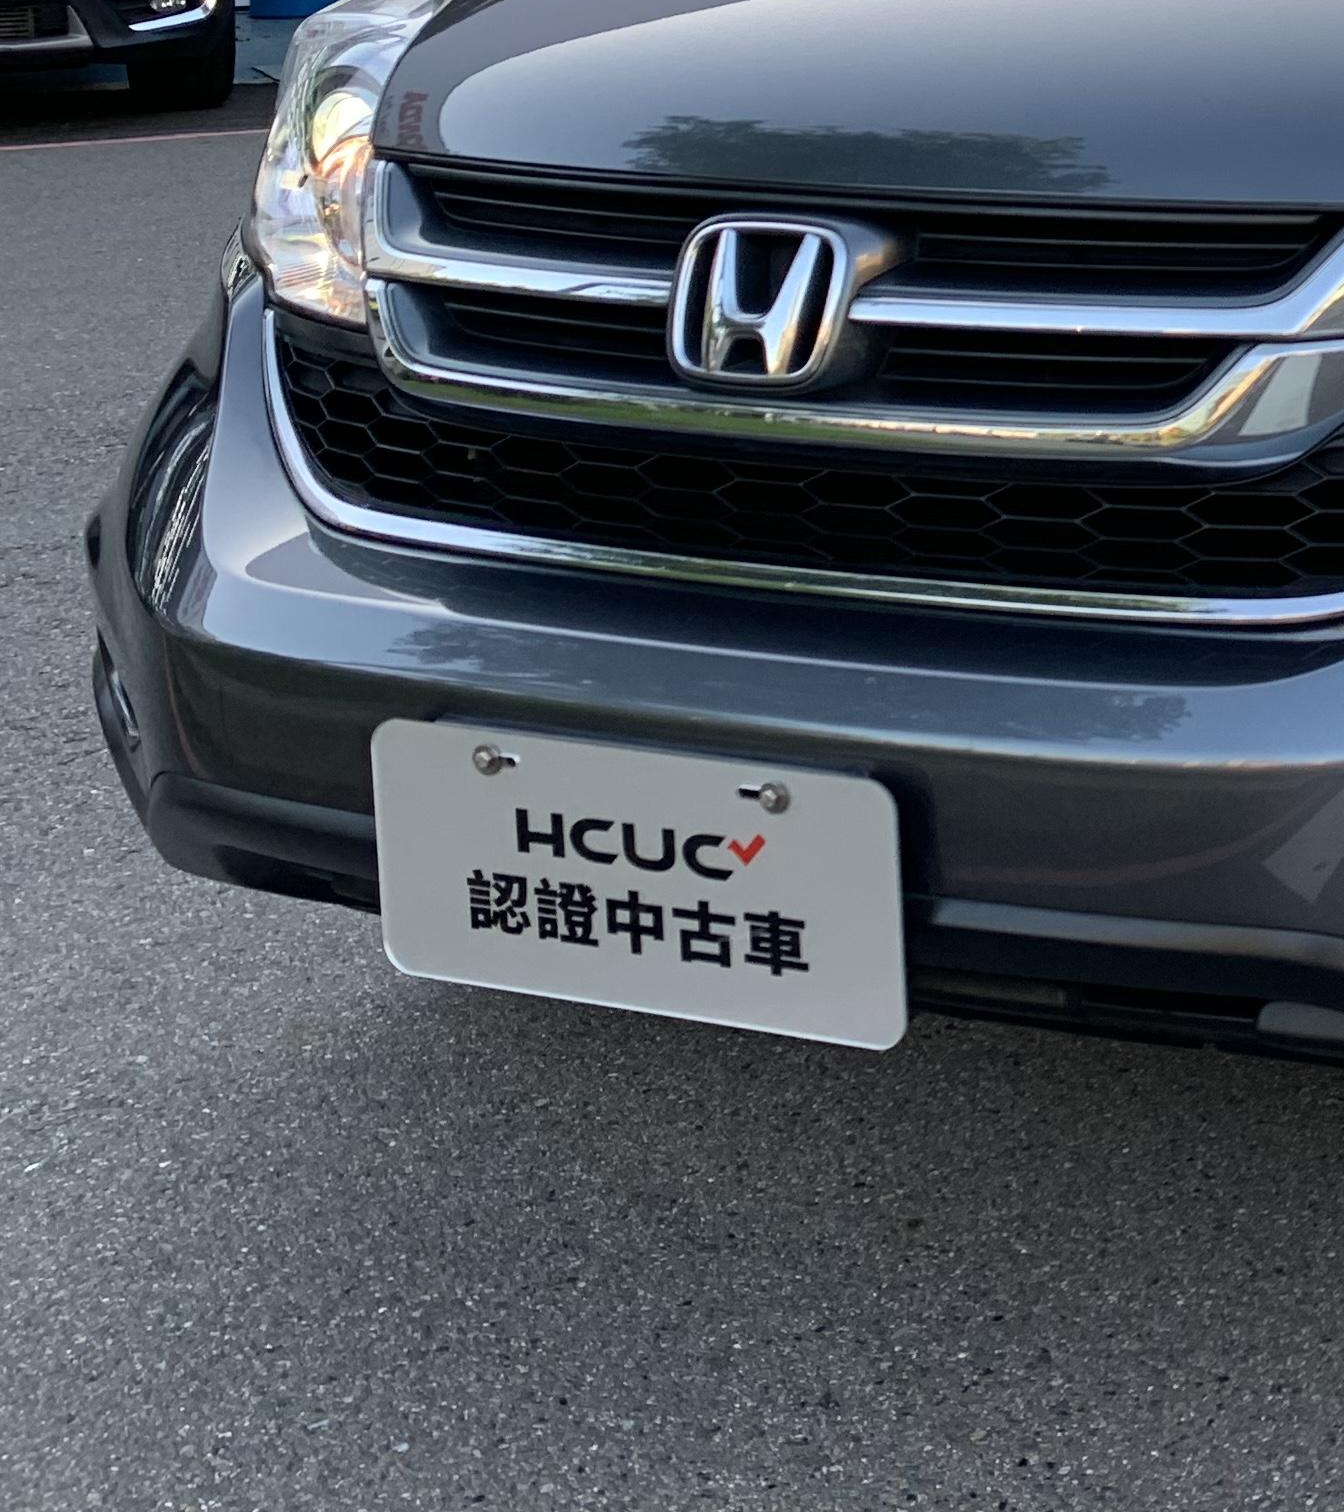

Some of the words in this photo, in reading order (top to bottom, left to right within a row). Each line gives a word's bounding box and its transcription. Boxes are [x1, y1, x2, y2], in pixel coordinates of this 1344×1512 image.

[514, 807, 735, 881] HCUC
[466, 869, 810, 976] 認證中古車
